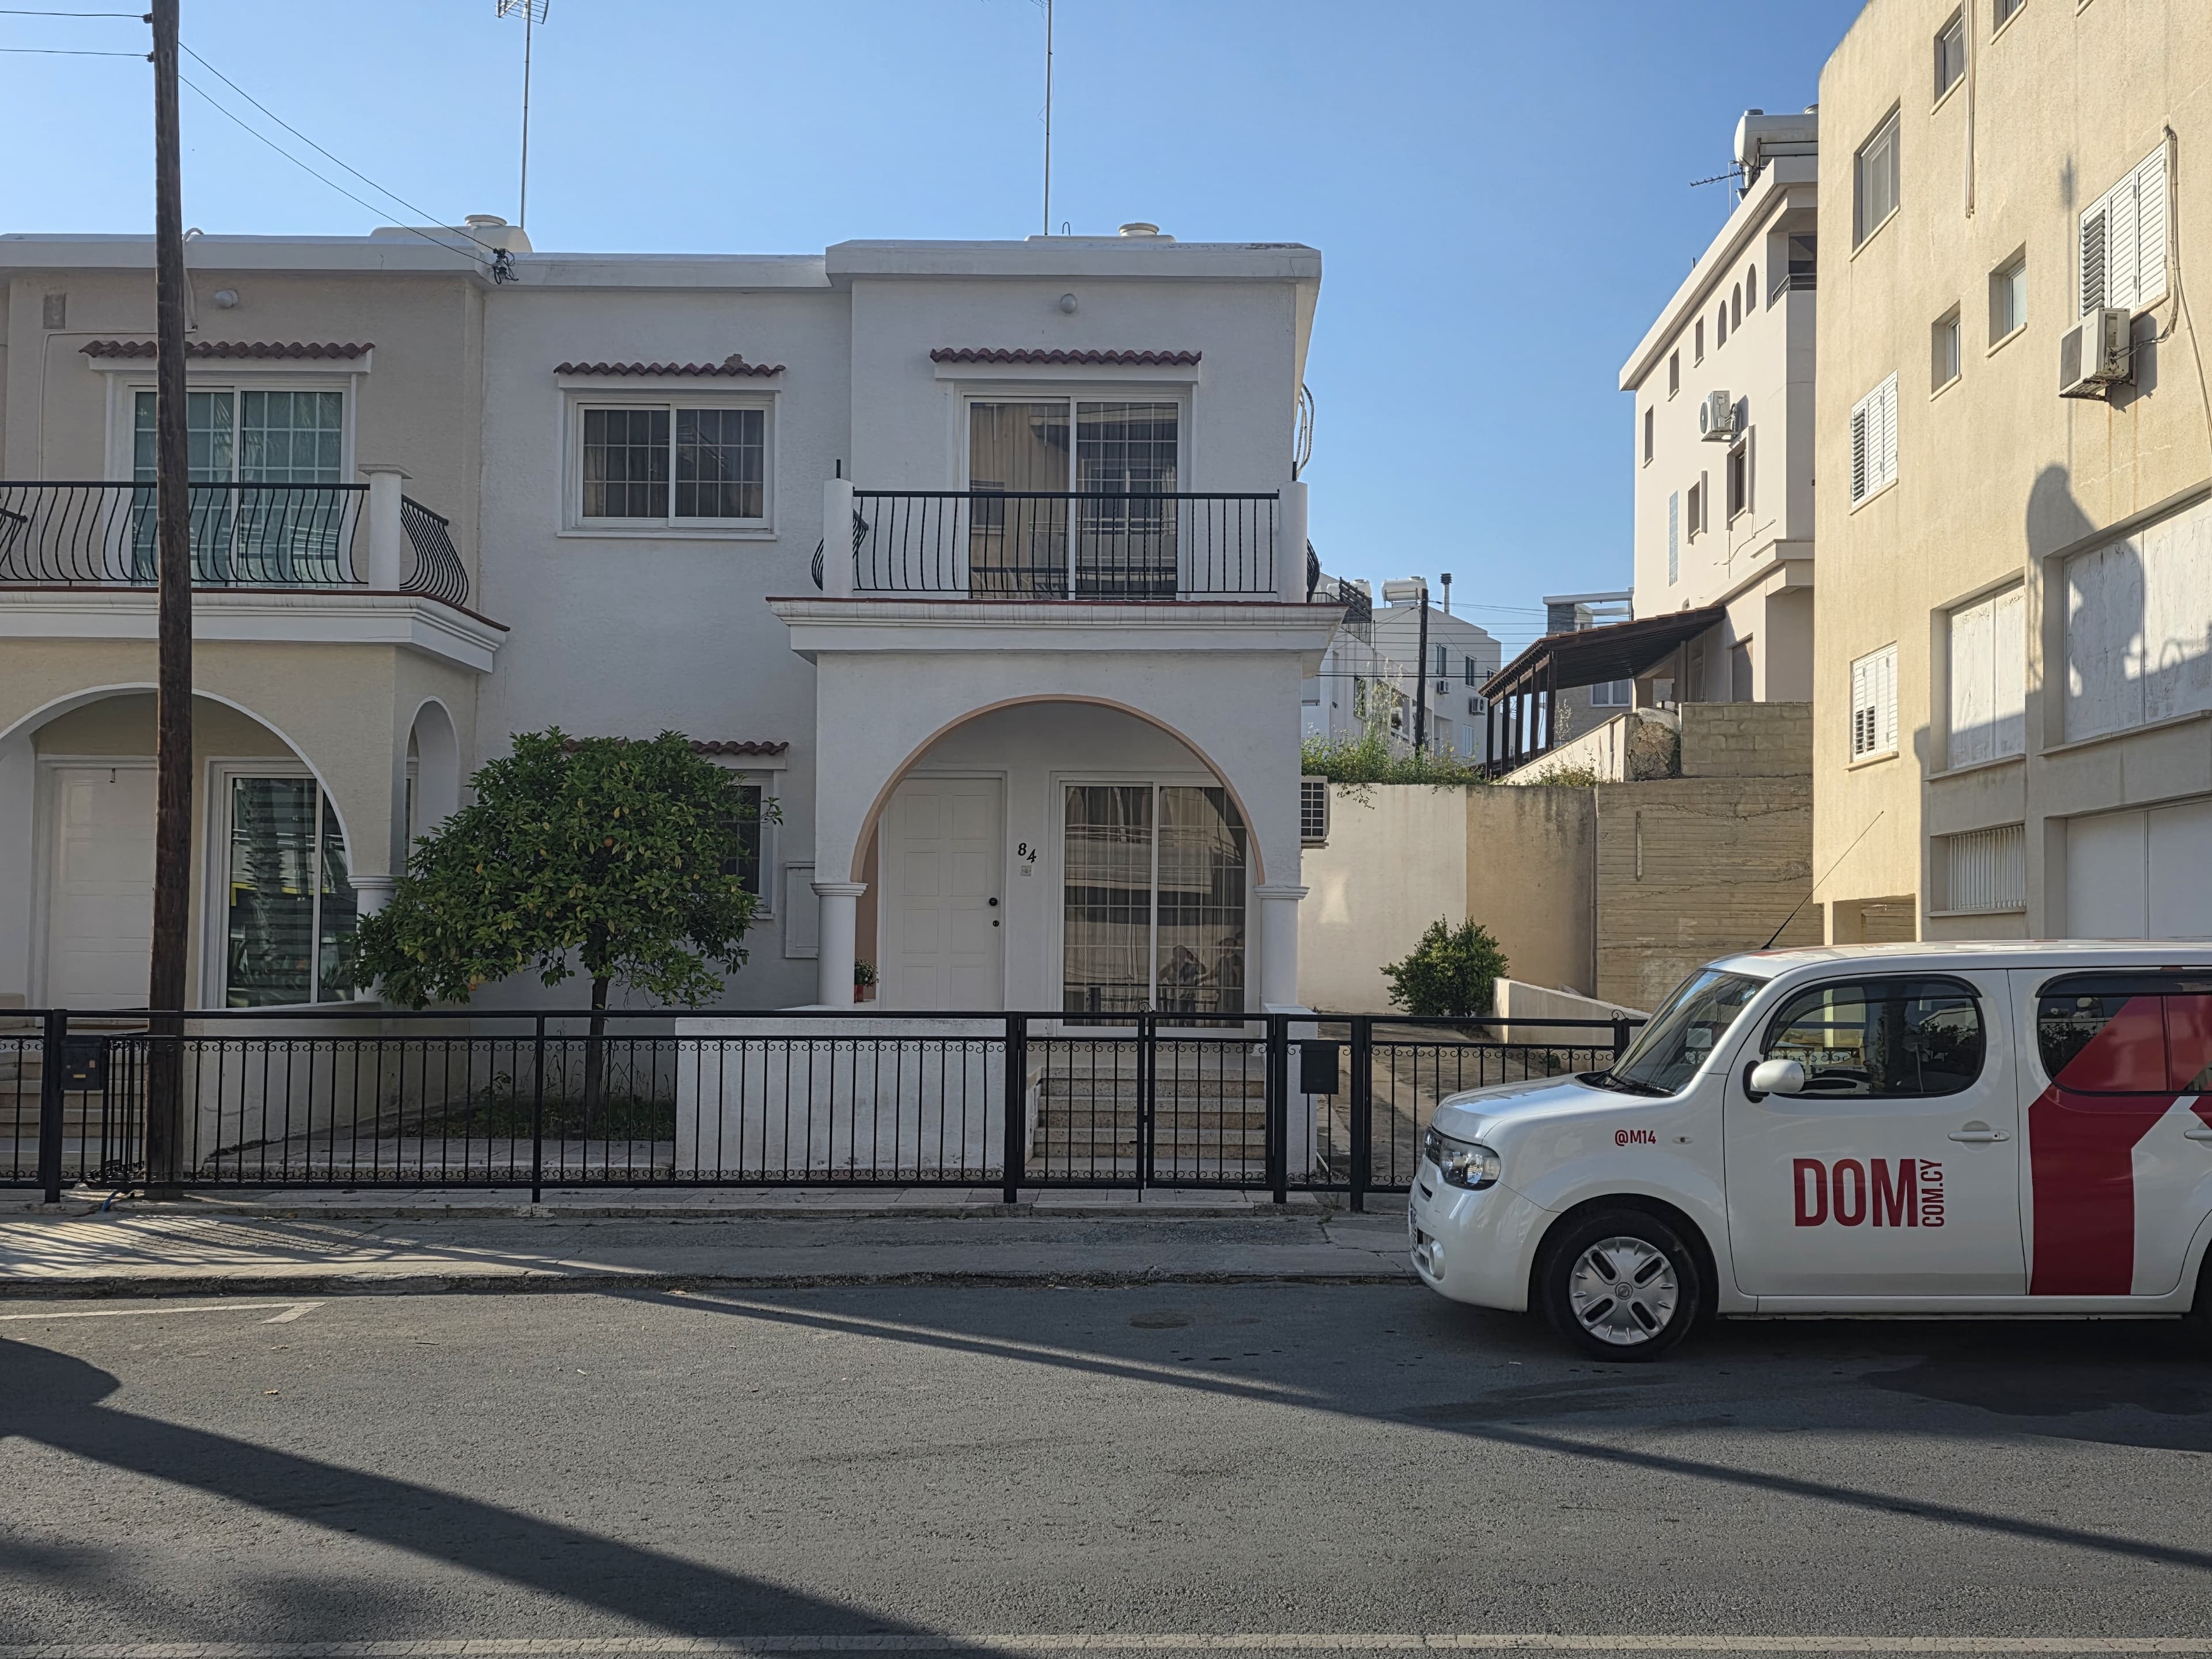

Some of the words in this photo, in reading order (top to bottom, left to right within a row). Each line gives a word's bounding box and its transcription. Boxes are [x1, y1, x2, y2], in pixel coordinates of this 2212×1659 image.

[1017, 842, 1037, 863] 84
[1615, 1130, 1656, 1146] @M14
[1793, 1158, 1918, 1226] DOM
[1920, 1158, 1944, 1227] COM.CY
